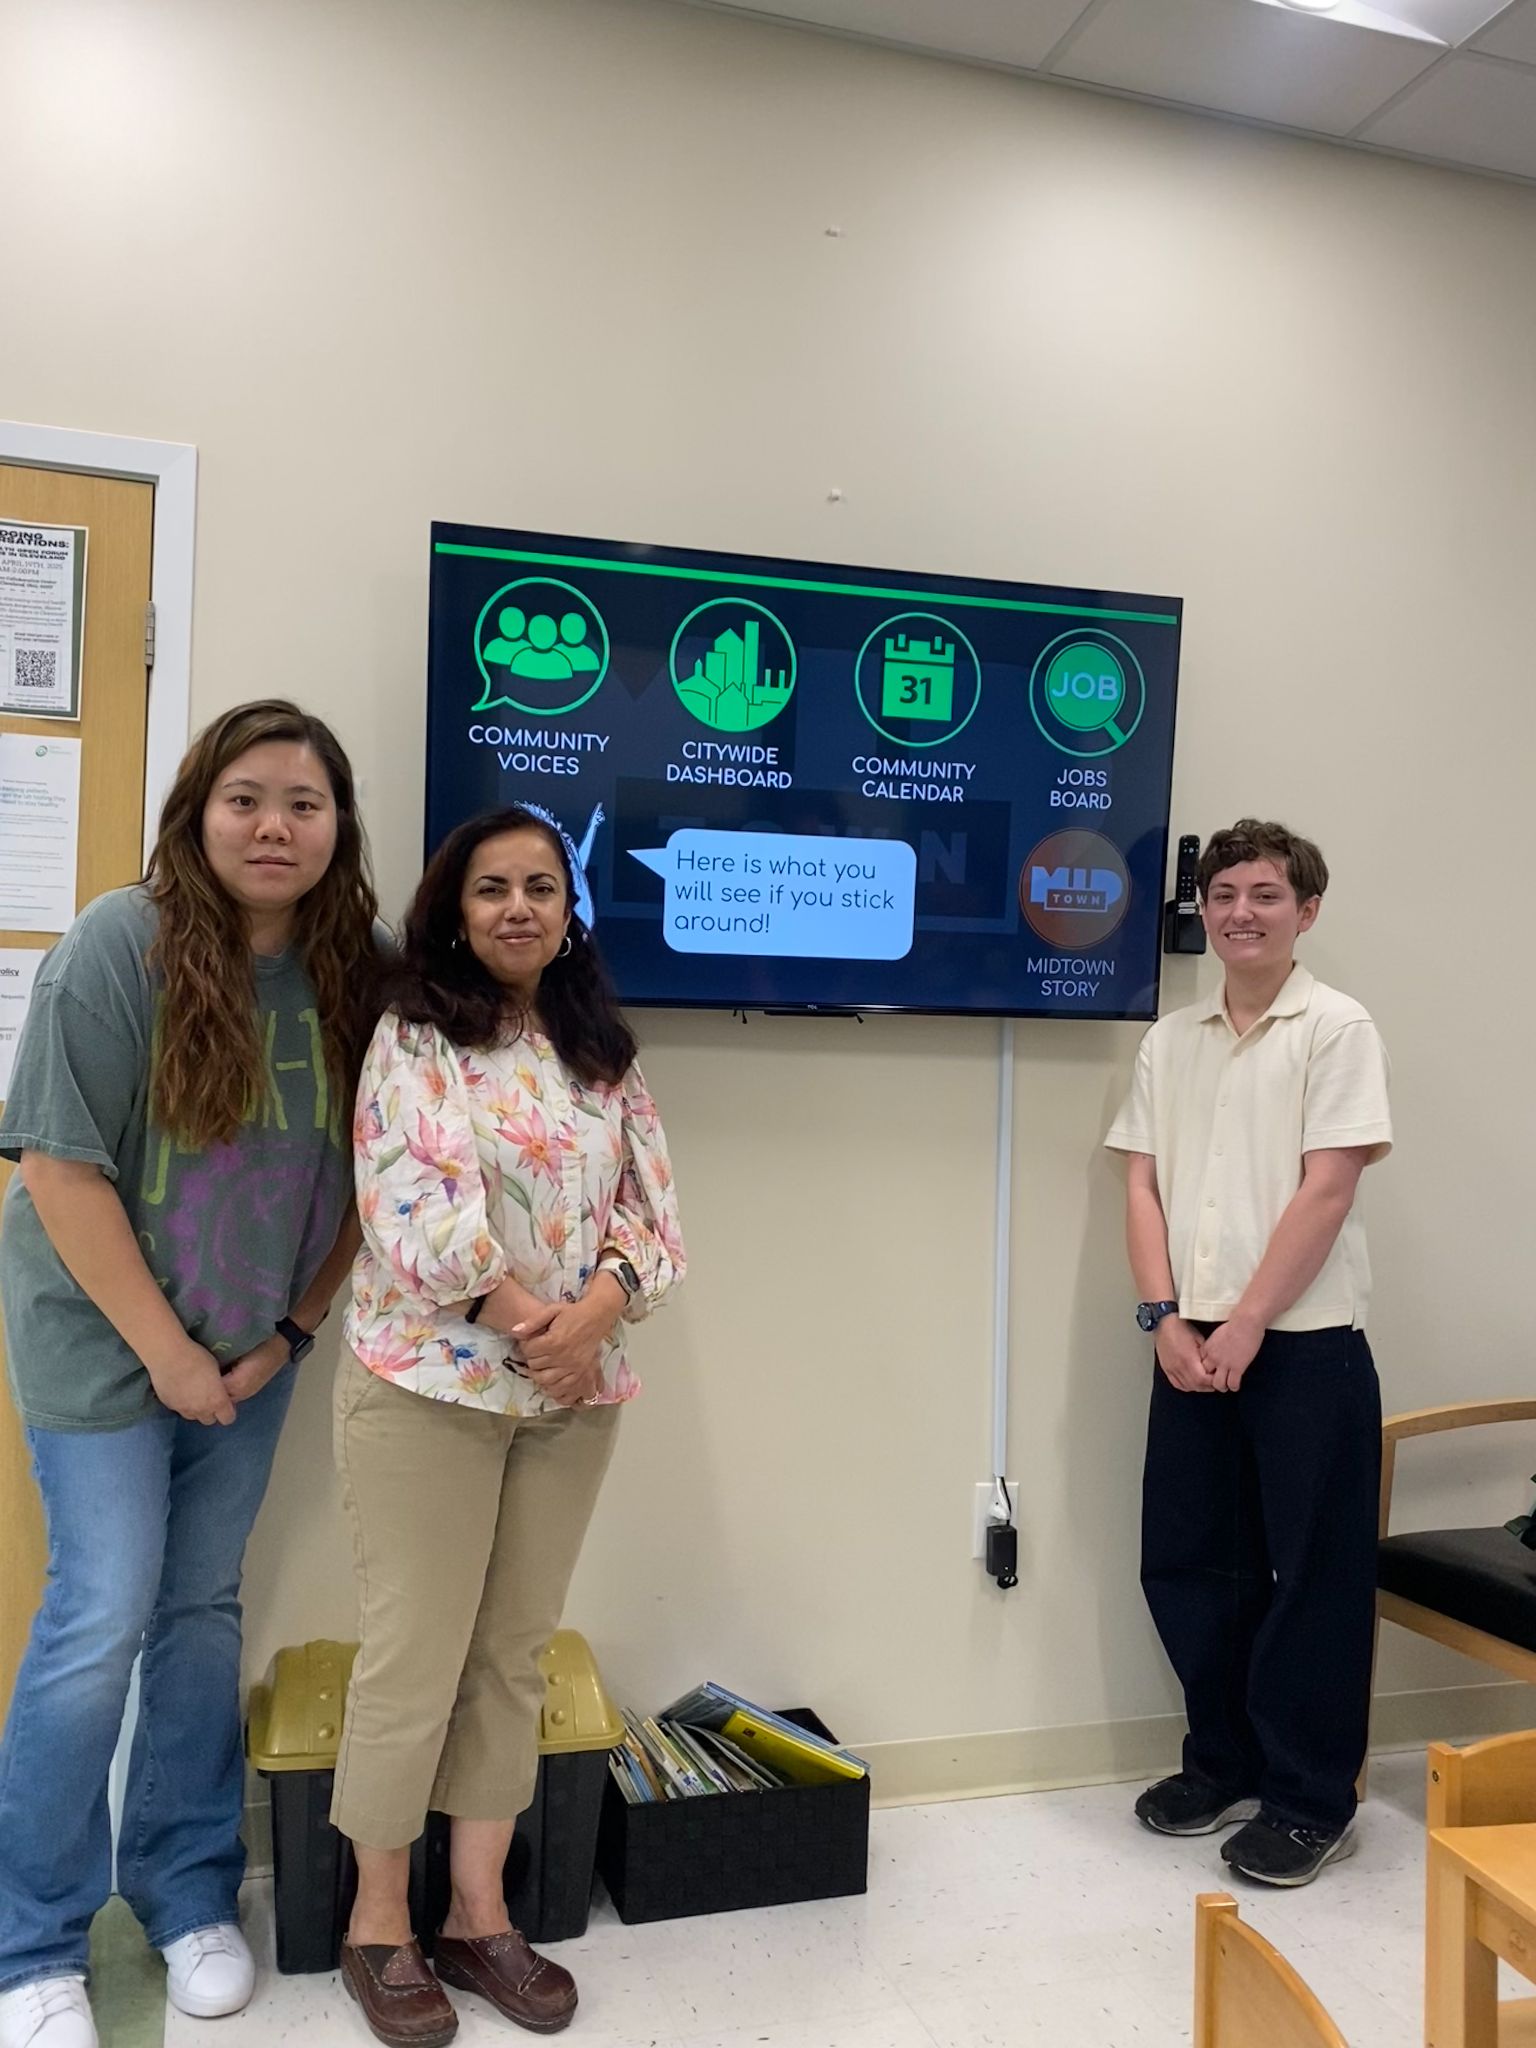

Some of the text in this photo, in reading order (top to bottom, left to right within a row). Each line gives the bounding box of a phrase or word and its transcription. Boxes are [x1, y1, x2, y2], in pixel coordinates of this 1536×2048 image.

[899, 675, 932, 705] 31
[1052, 671, 1119, 701] JOB
[468, 724, 610, 753] COMMUNITY
[497, 751, 580, 775] VOICES
[682, 741, 779, 765] CITYWIDE
[666, 763, 793, 789] DASHBOARD
[852, 756, 976, 780] COMMUNITY
[1057, 768, 1107, 787] JOBS
[862, 780, 964, 802] CALENDAR
[1050, 790, 1112, 810] BOARD
[677, 849, 876, 884] Here is what you
[674, 882, 895, 911] will see if you stick
[1030, 866, 1123, 905] MID
[1053, 894, 1100, 904] TOWN
[674, 914, 770, 934] around!
[0, 967, 20, 976] olicy
[1027, 957, 1115, 975] MIDTOWN
[1041, 979, 1100, 997] STORY
